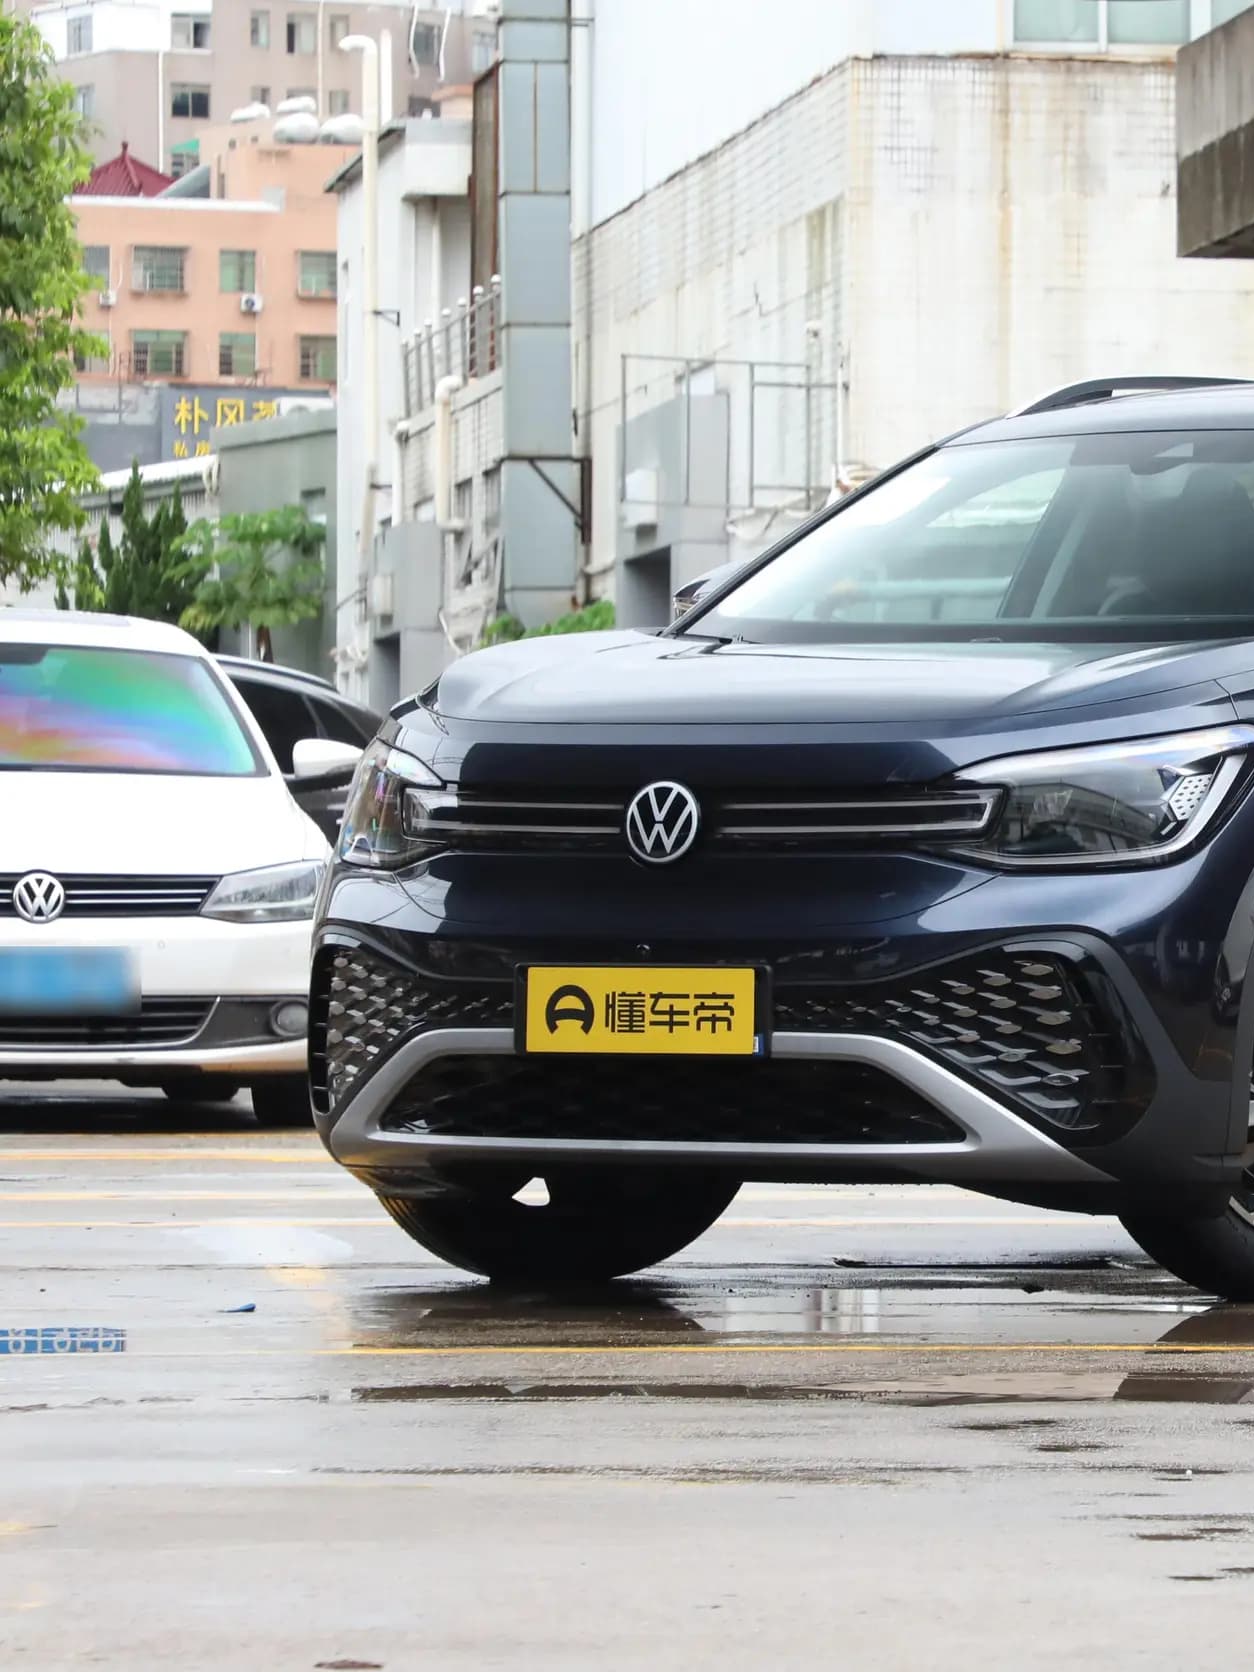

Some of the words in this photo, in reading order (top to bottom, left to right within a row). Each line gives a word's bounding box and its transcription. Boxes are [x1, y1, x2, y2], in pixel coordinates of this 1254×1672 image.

[626, 781, 698, 863] VW
[605, 991, 735, 1034] 懂车帝
